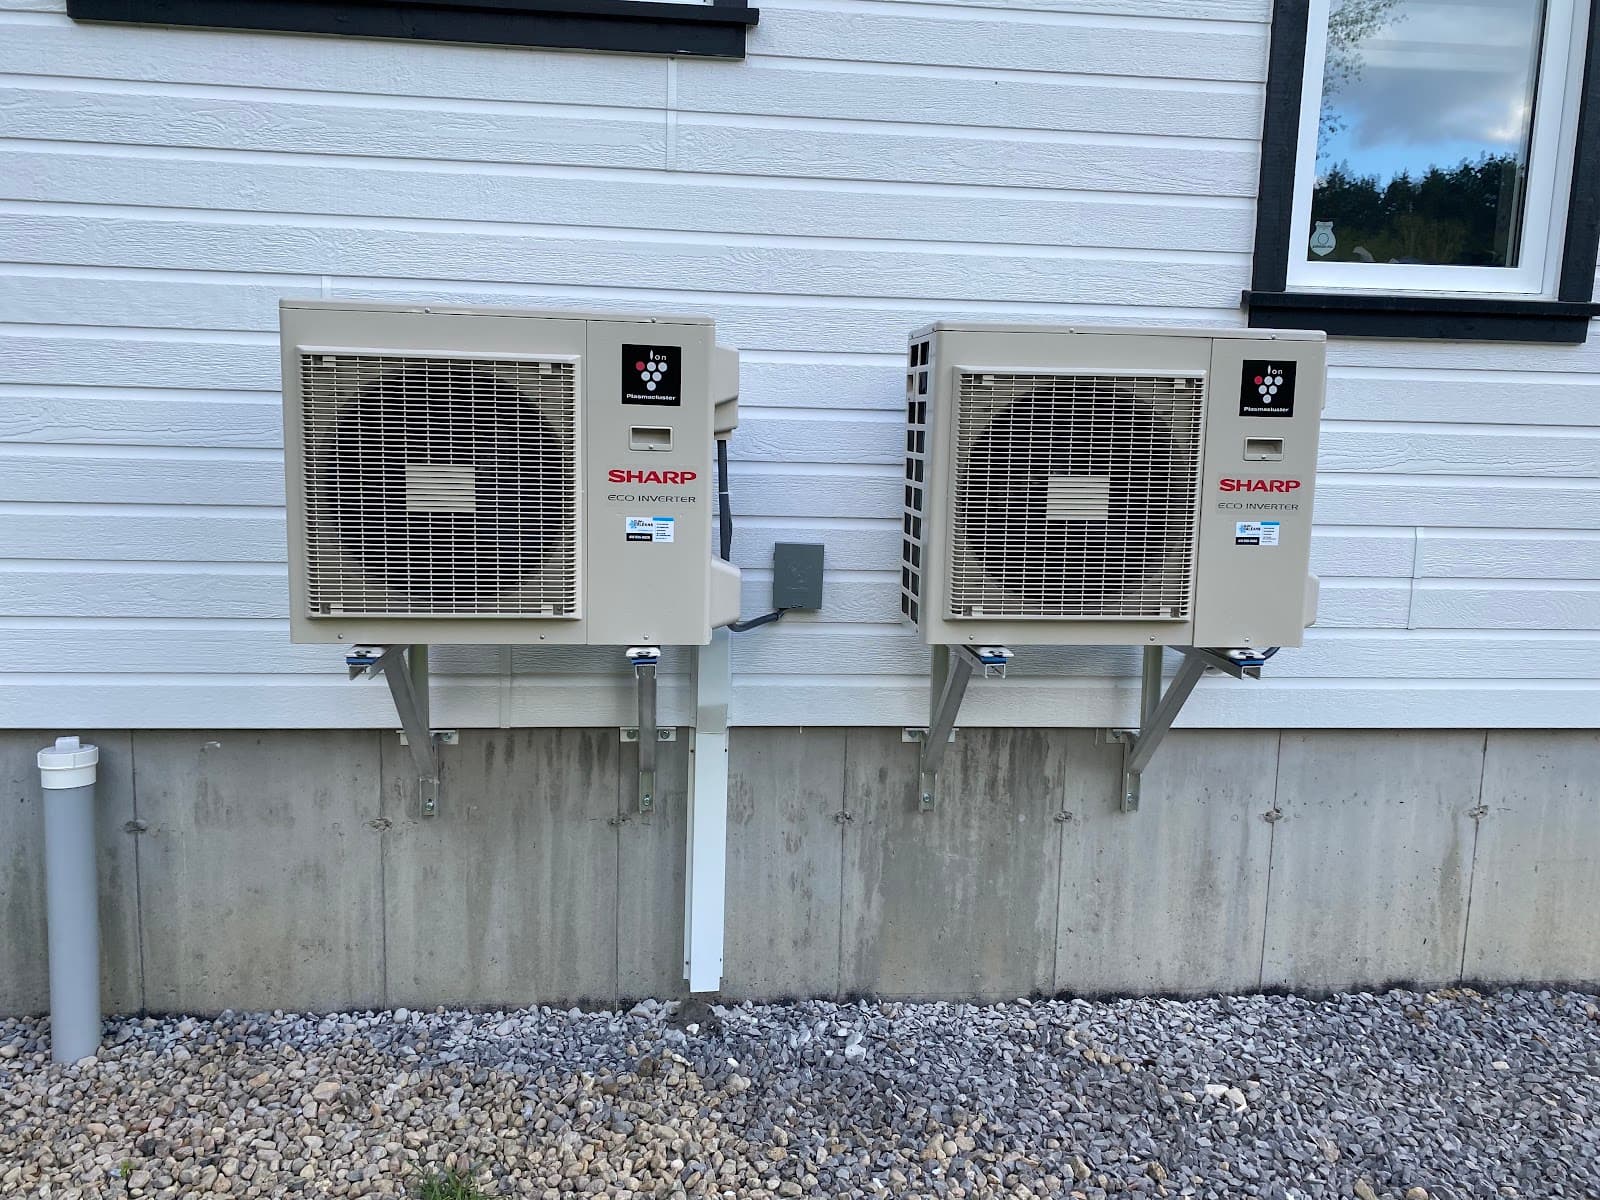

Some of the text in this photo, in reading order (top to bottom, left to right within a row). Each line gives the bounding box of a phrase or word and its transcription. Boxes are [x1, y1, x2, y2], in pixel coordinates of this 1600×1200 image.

[649, 349, 667, 361] Ion
[1267, 364, 1283, 375] Ion
[626, 393, 676, 401] Plasmacluster
[608, 469, 697, 485] SHARP
[1219, 478, 1301, 493] SHARP
[607, 494, 696, 503] ECO INVERTER
[1246, 503, 1299, 511] INVERTER
